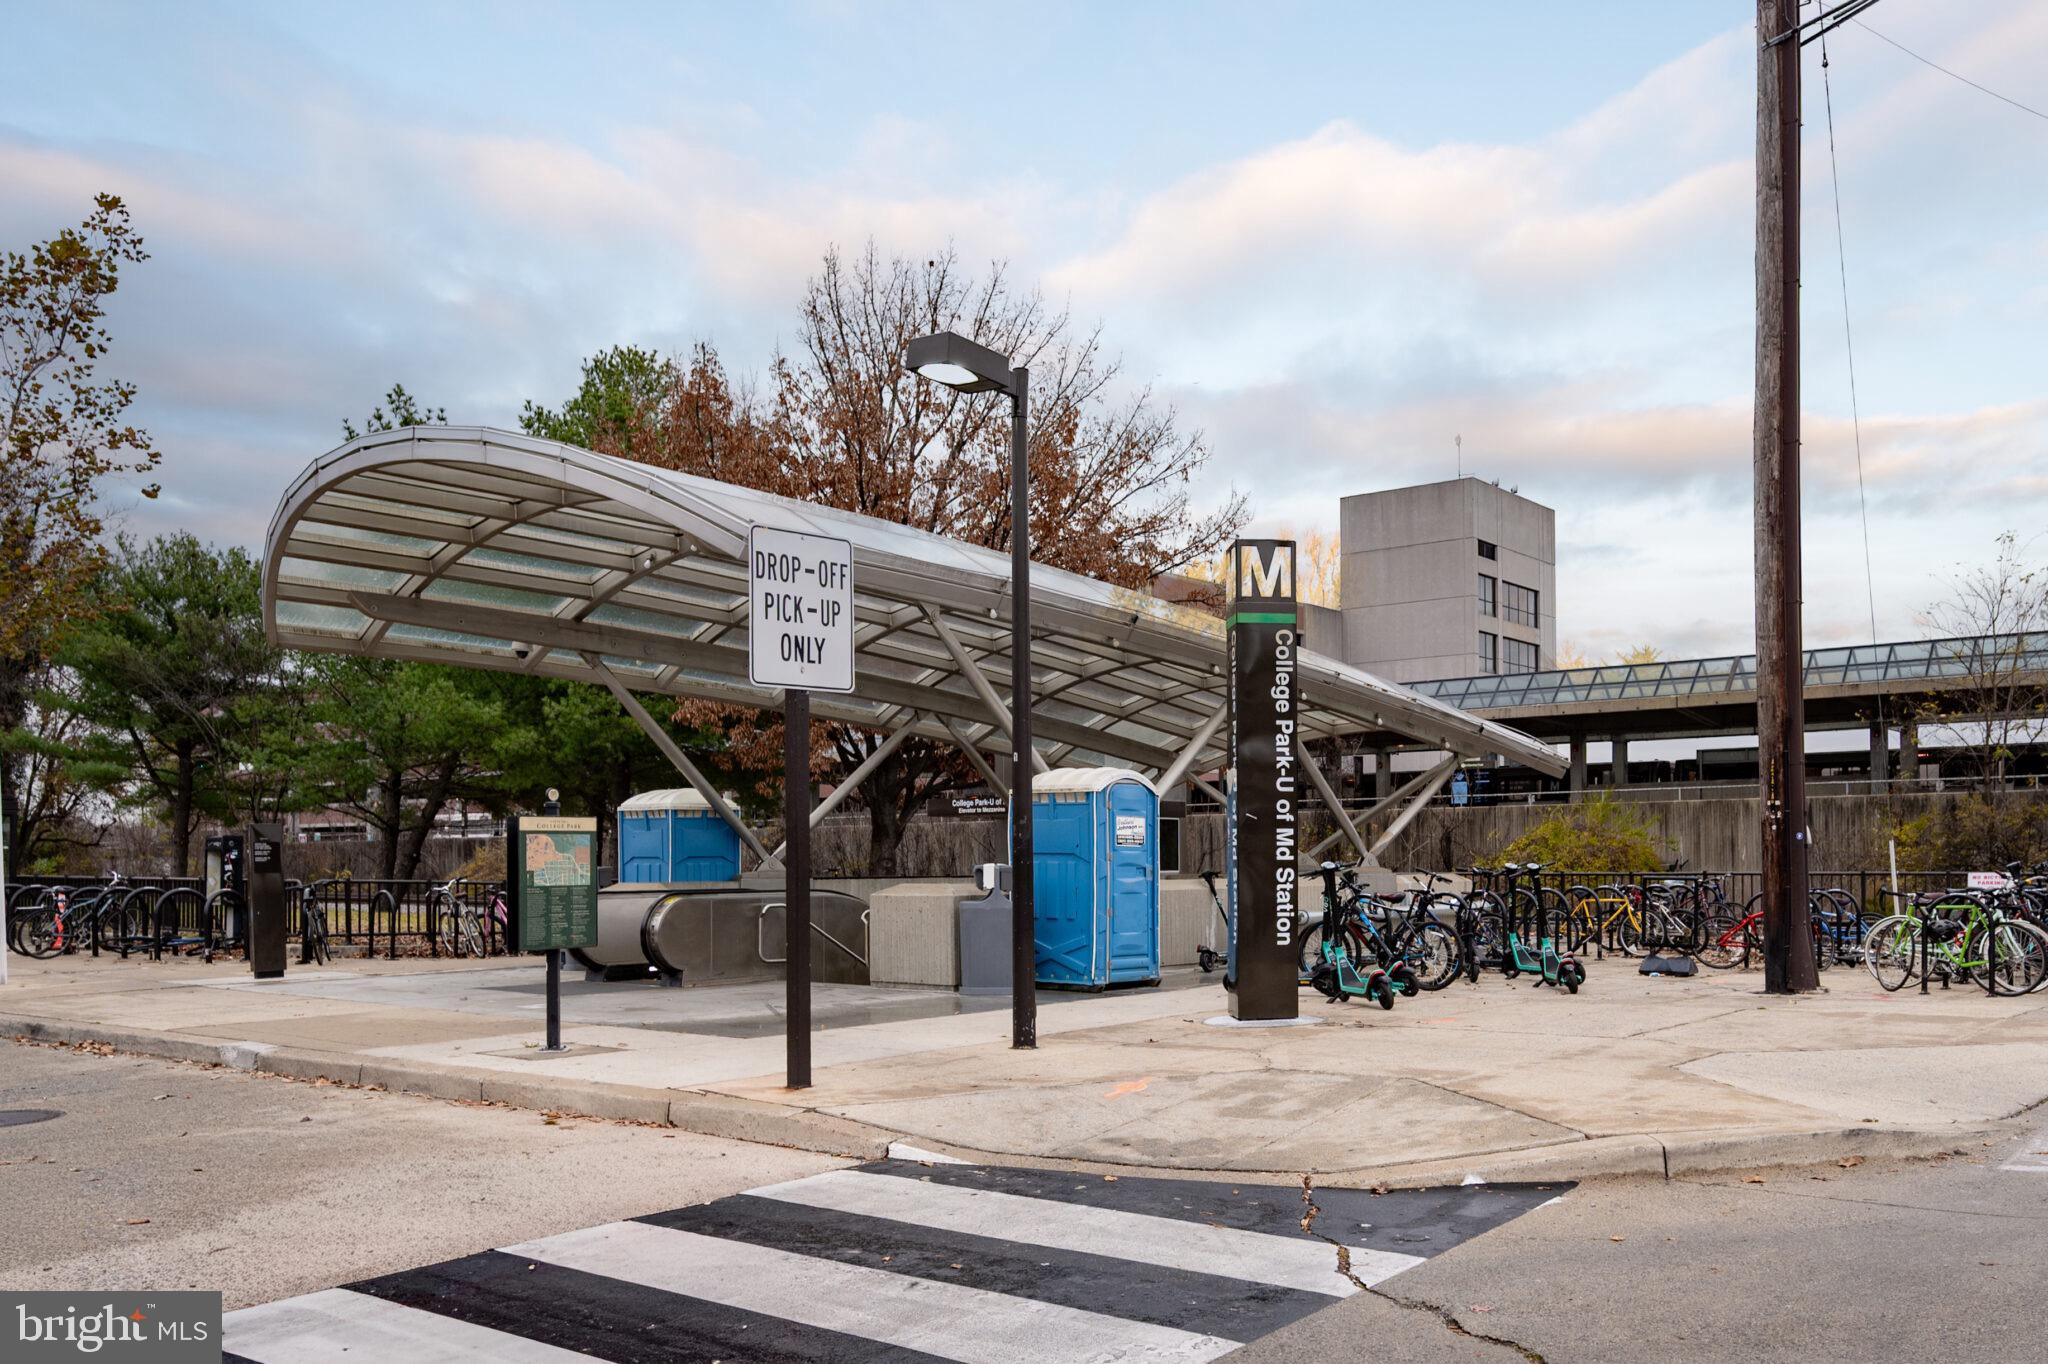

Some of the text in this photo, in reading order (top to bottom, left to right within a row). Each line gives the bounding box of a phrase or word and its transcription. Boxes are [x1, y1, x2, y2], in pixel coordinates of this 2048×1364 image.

[755, 551, 848, 590] DROP-OFF
[1241, 545, 1292, 598] M
[765, 592, 841, 628] PICK-UP
[780, 633, 826, 664] ONLY
[952, 799, 974, 808] College
[1270, 629, 1295, 946] College Park-U of Md Station
